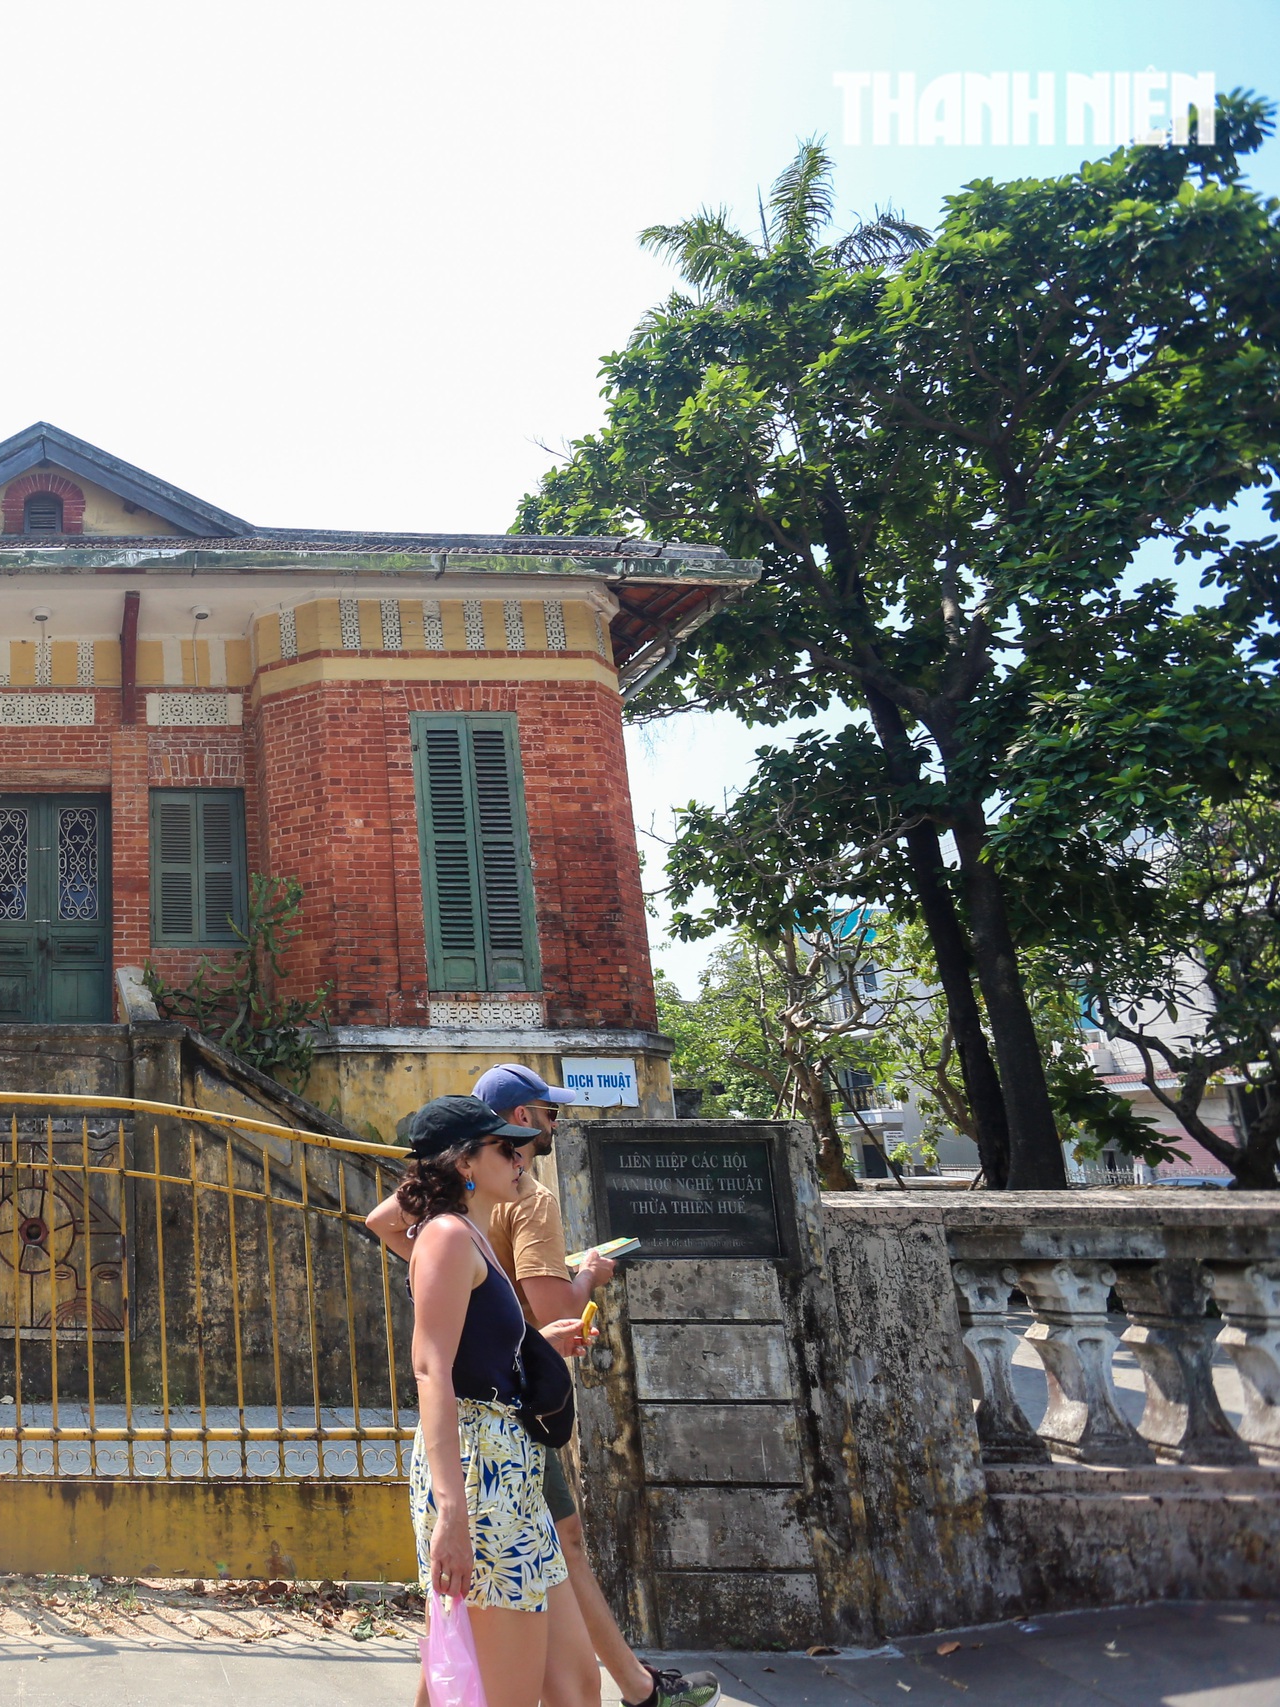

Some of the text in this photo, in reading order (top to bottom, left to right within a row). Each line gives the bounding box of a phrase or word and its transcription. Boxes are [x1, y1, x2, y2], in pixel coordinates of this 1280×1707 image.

[567, 1072, 631, 1091] DỊCH THUẬT
[619, 1151, 748, 1171] LIÊN HIỆP CÁC HỘI
[644, 1177, 672, 1194] HỌC
[675, 1174, 715, 1194] NGHỆ
[717, 1174, 763, 1194] THUẬT
[630, 1194, 747, 1214] THỪA THIÊN HUẾ
